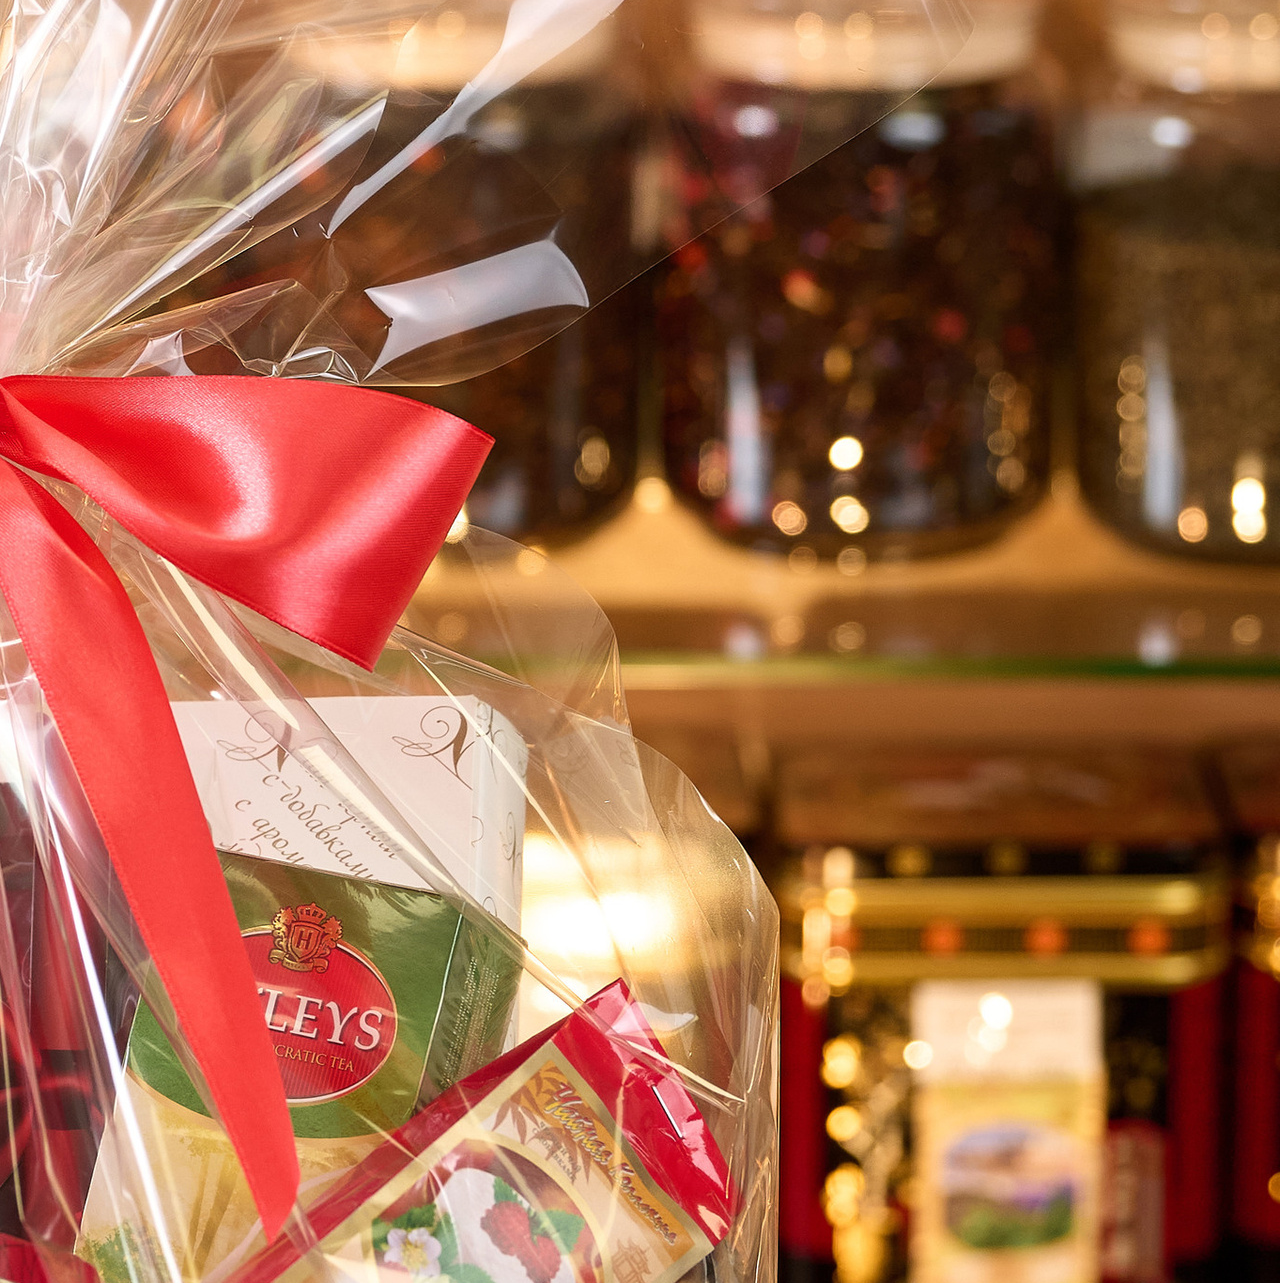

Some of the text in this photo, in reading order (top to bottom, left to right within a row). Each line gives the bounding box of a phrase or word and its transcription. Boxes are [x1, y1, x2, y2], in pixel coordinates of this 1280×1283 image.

[296, 929, 313, 951] H
[257, 986, 383, 1052] LEYS
[330, 1055, 355, 1073] TEA
